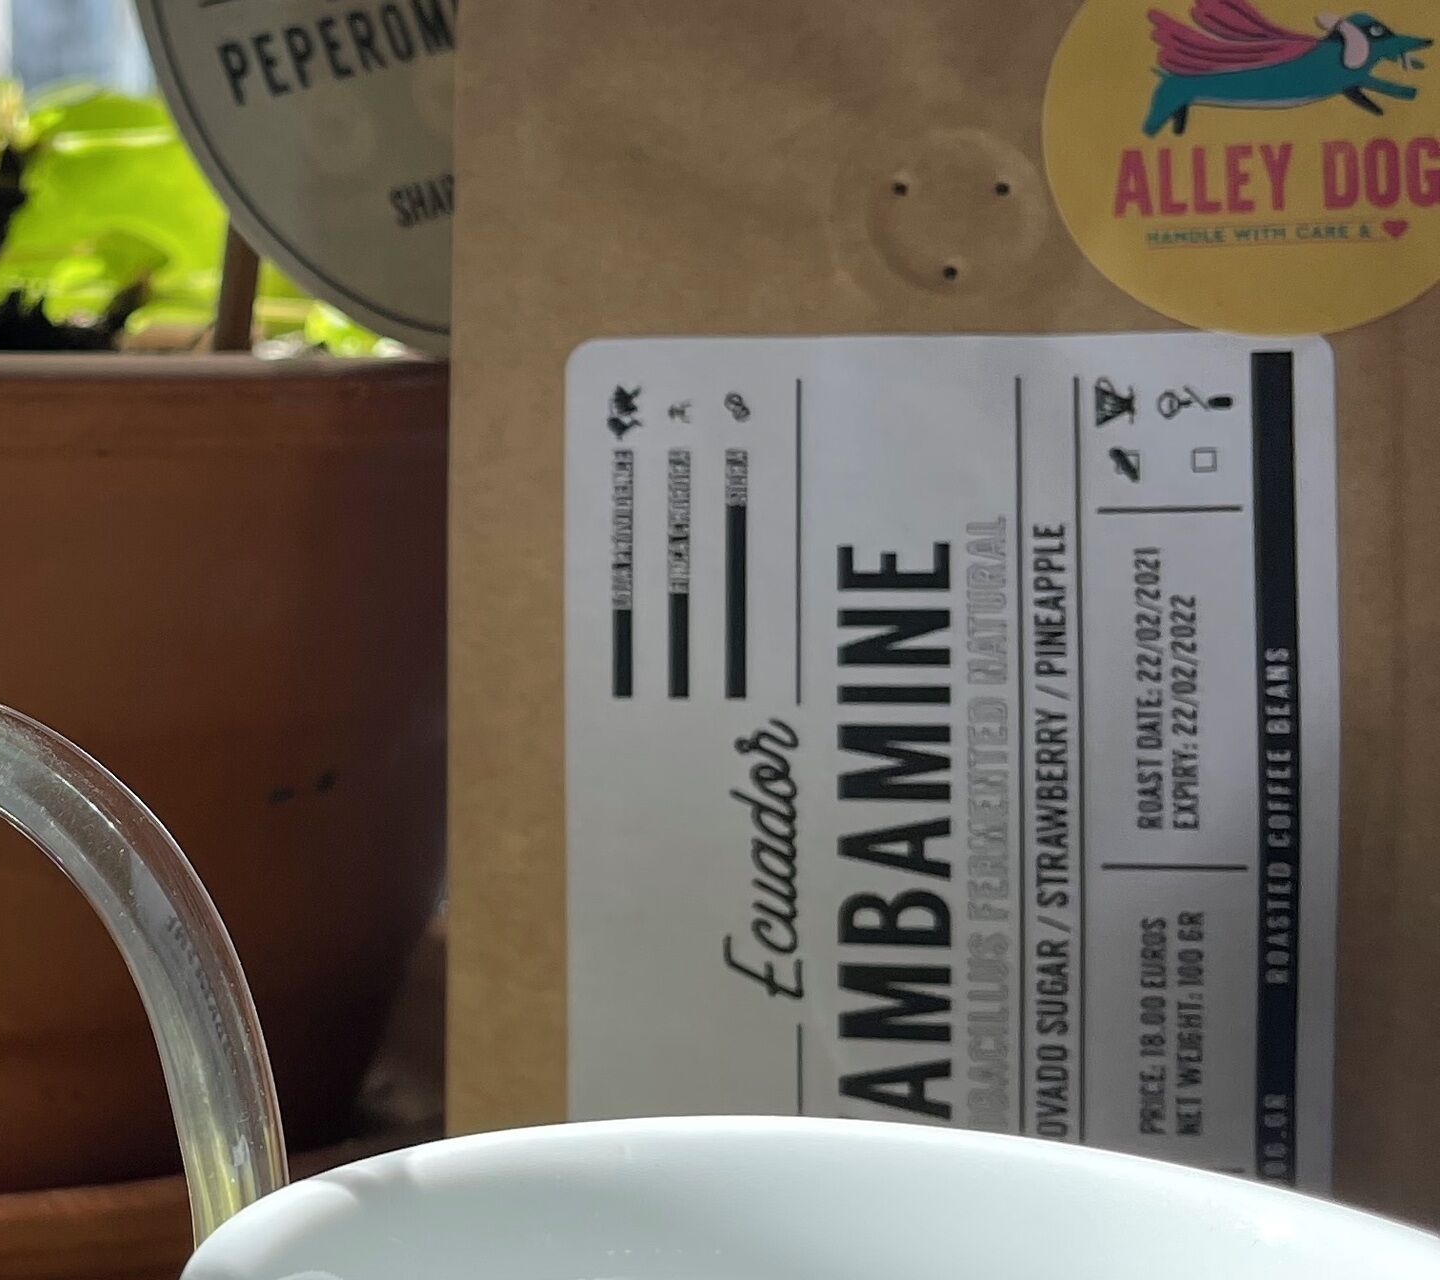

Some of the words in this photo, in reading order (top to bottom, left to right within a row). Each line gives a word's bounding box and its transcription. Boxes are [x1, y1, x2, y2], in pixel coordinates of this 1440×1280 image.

[1113, 142, 1293, 218] ALLEY
[1321, 137, 1440, 211] DOG
[1147, 226, 1226, 244] HANDLE
[1233, 226, 1287, 240] WITH
[1295, 224, 1349, 239] CARE
[966, 515, 1007, 685] NATURAL
[1032, 524, 1068, 679] PINEAPPLE
[1133, 546, 1163, 683] 22/02/2021
[1169, 594, 1199, 737] 22/02/2022
[1264, 647, 1291, 735] BEANS
[1136, 688, 1163, 750] DATE:
[837, 542, 952, 1120] AMBAMINE
[967, 697, 1009, 921] FERMENTED
[1034, 708, 1071, 908] STRAWBERRY
[1137, 757, 1164, 830] ROAST
[1171, 743, 1200, 831] EXPIRY:
[1265, 749, 1292, 848] COFFEE
[723, 718, 804, 1000] Ecuador
[1140, 917, 1167, 990] EUROS
[1176, 947, 1204, 987] 100
[1177, 911, 1205, 942] GR
[1264, 862, 1292, 984] ROASTED
[1035, 939, 1071, 1037] SUGAR
[1176, 992, 1204, 1088] WEIGHT:
[1035, 1043, 1071, 1138] OVADO
[1176, 1095, 1203, 1136] NET
